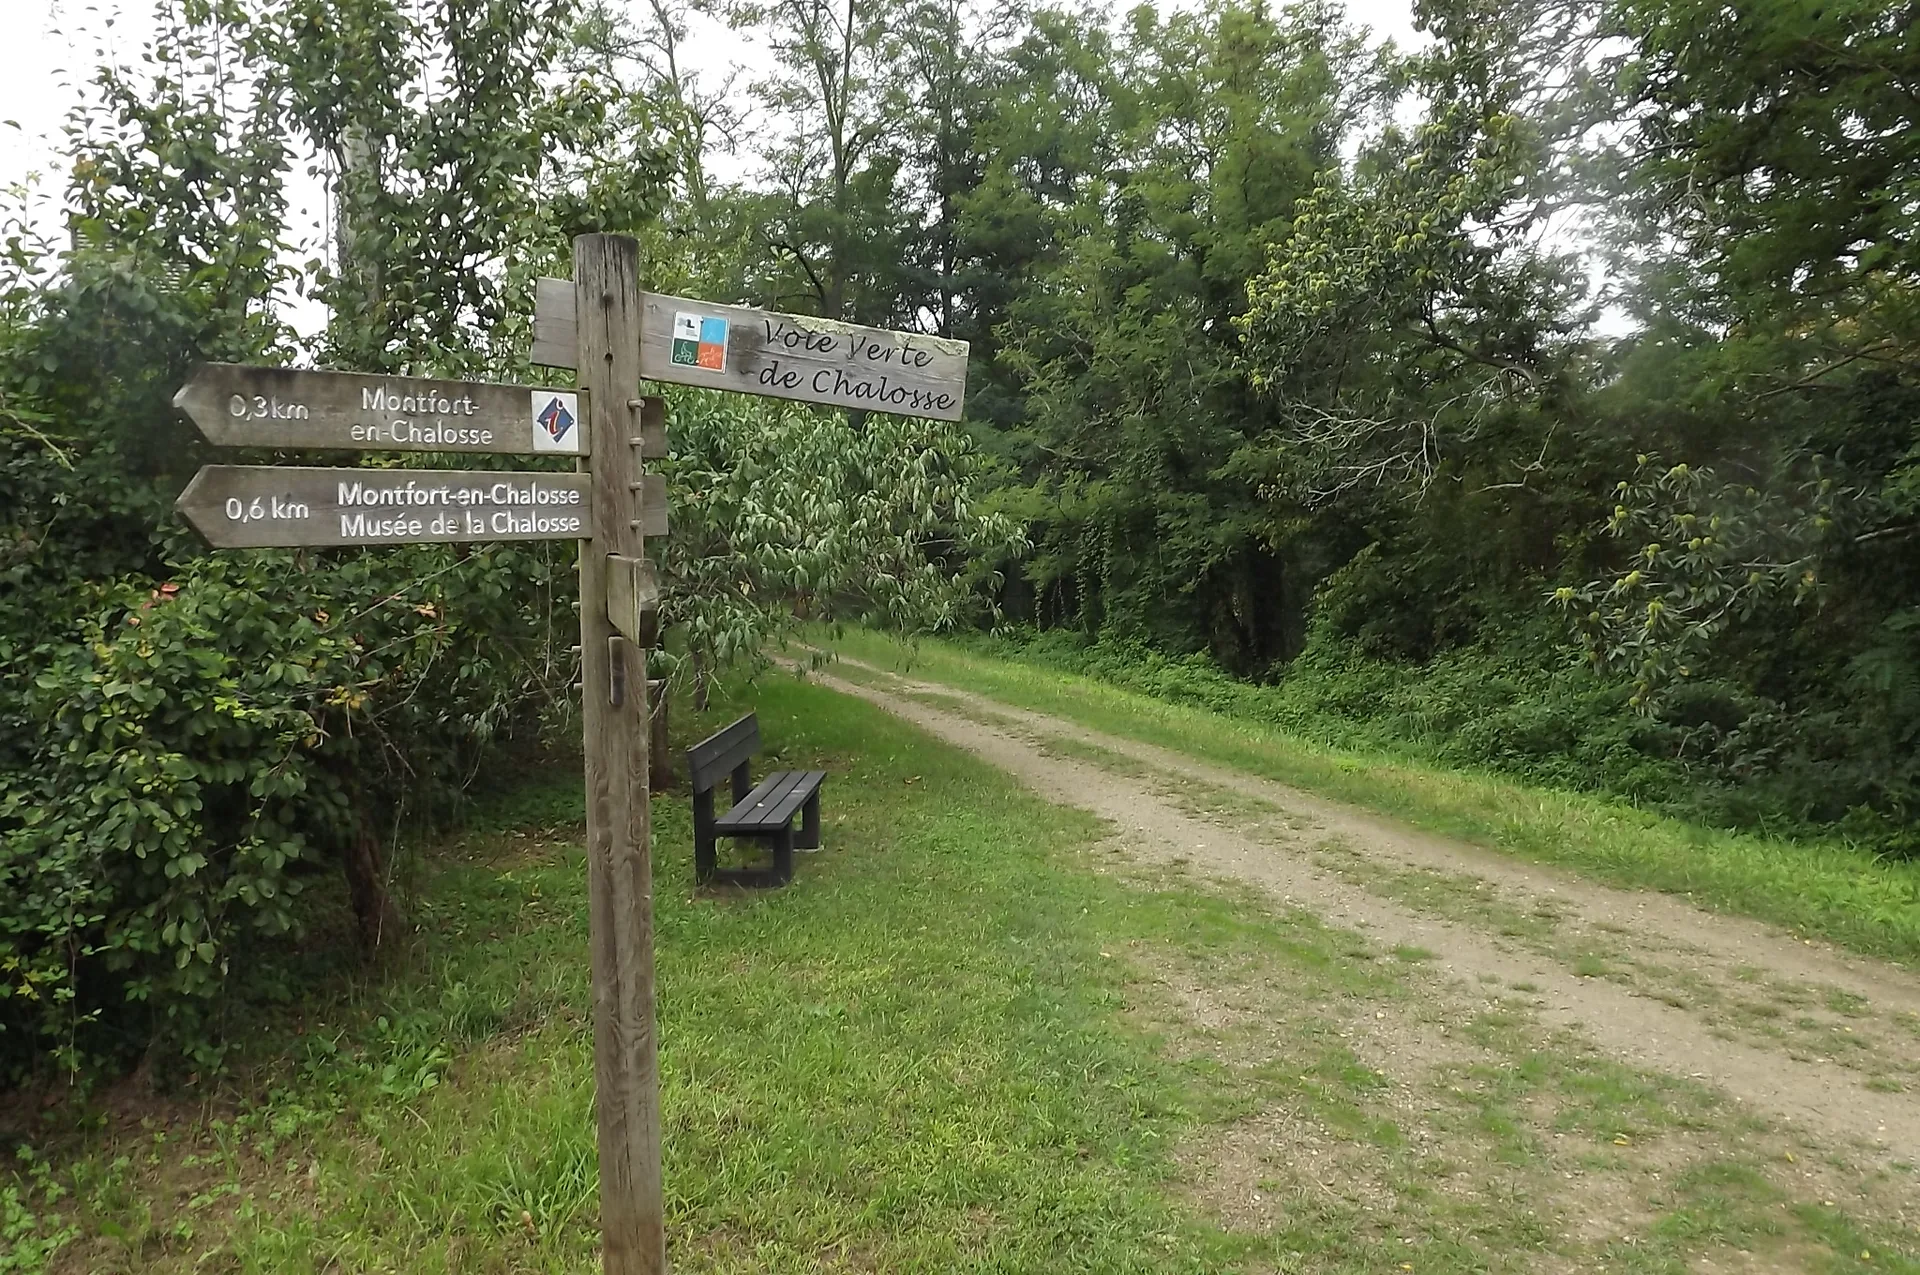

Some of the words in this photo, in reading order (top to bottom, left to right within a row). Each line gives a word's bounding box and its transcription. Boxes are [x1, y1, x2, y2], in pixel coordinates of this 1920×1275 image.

[765, 319, 838, 353] Voie
[849, 333, 934, 367] Verte
[759, 360, 804, 388] de
[812, 369, 956, 411] Chalosse
[350, 419, 493, 445] en-Chalosse
[337, 480, 580, 506] Montfort-en-Chalosse
[271, 495, 309, 519] km
[340, 511, 423, 538] Musée
[430, 512, 459, 535] de
[466, 510, 485, 535] la
[491, 511, 581, 534] Chalosse
